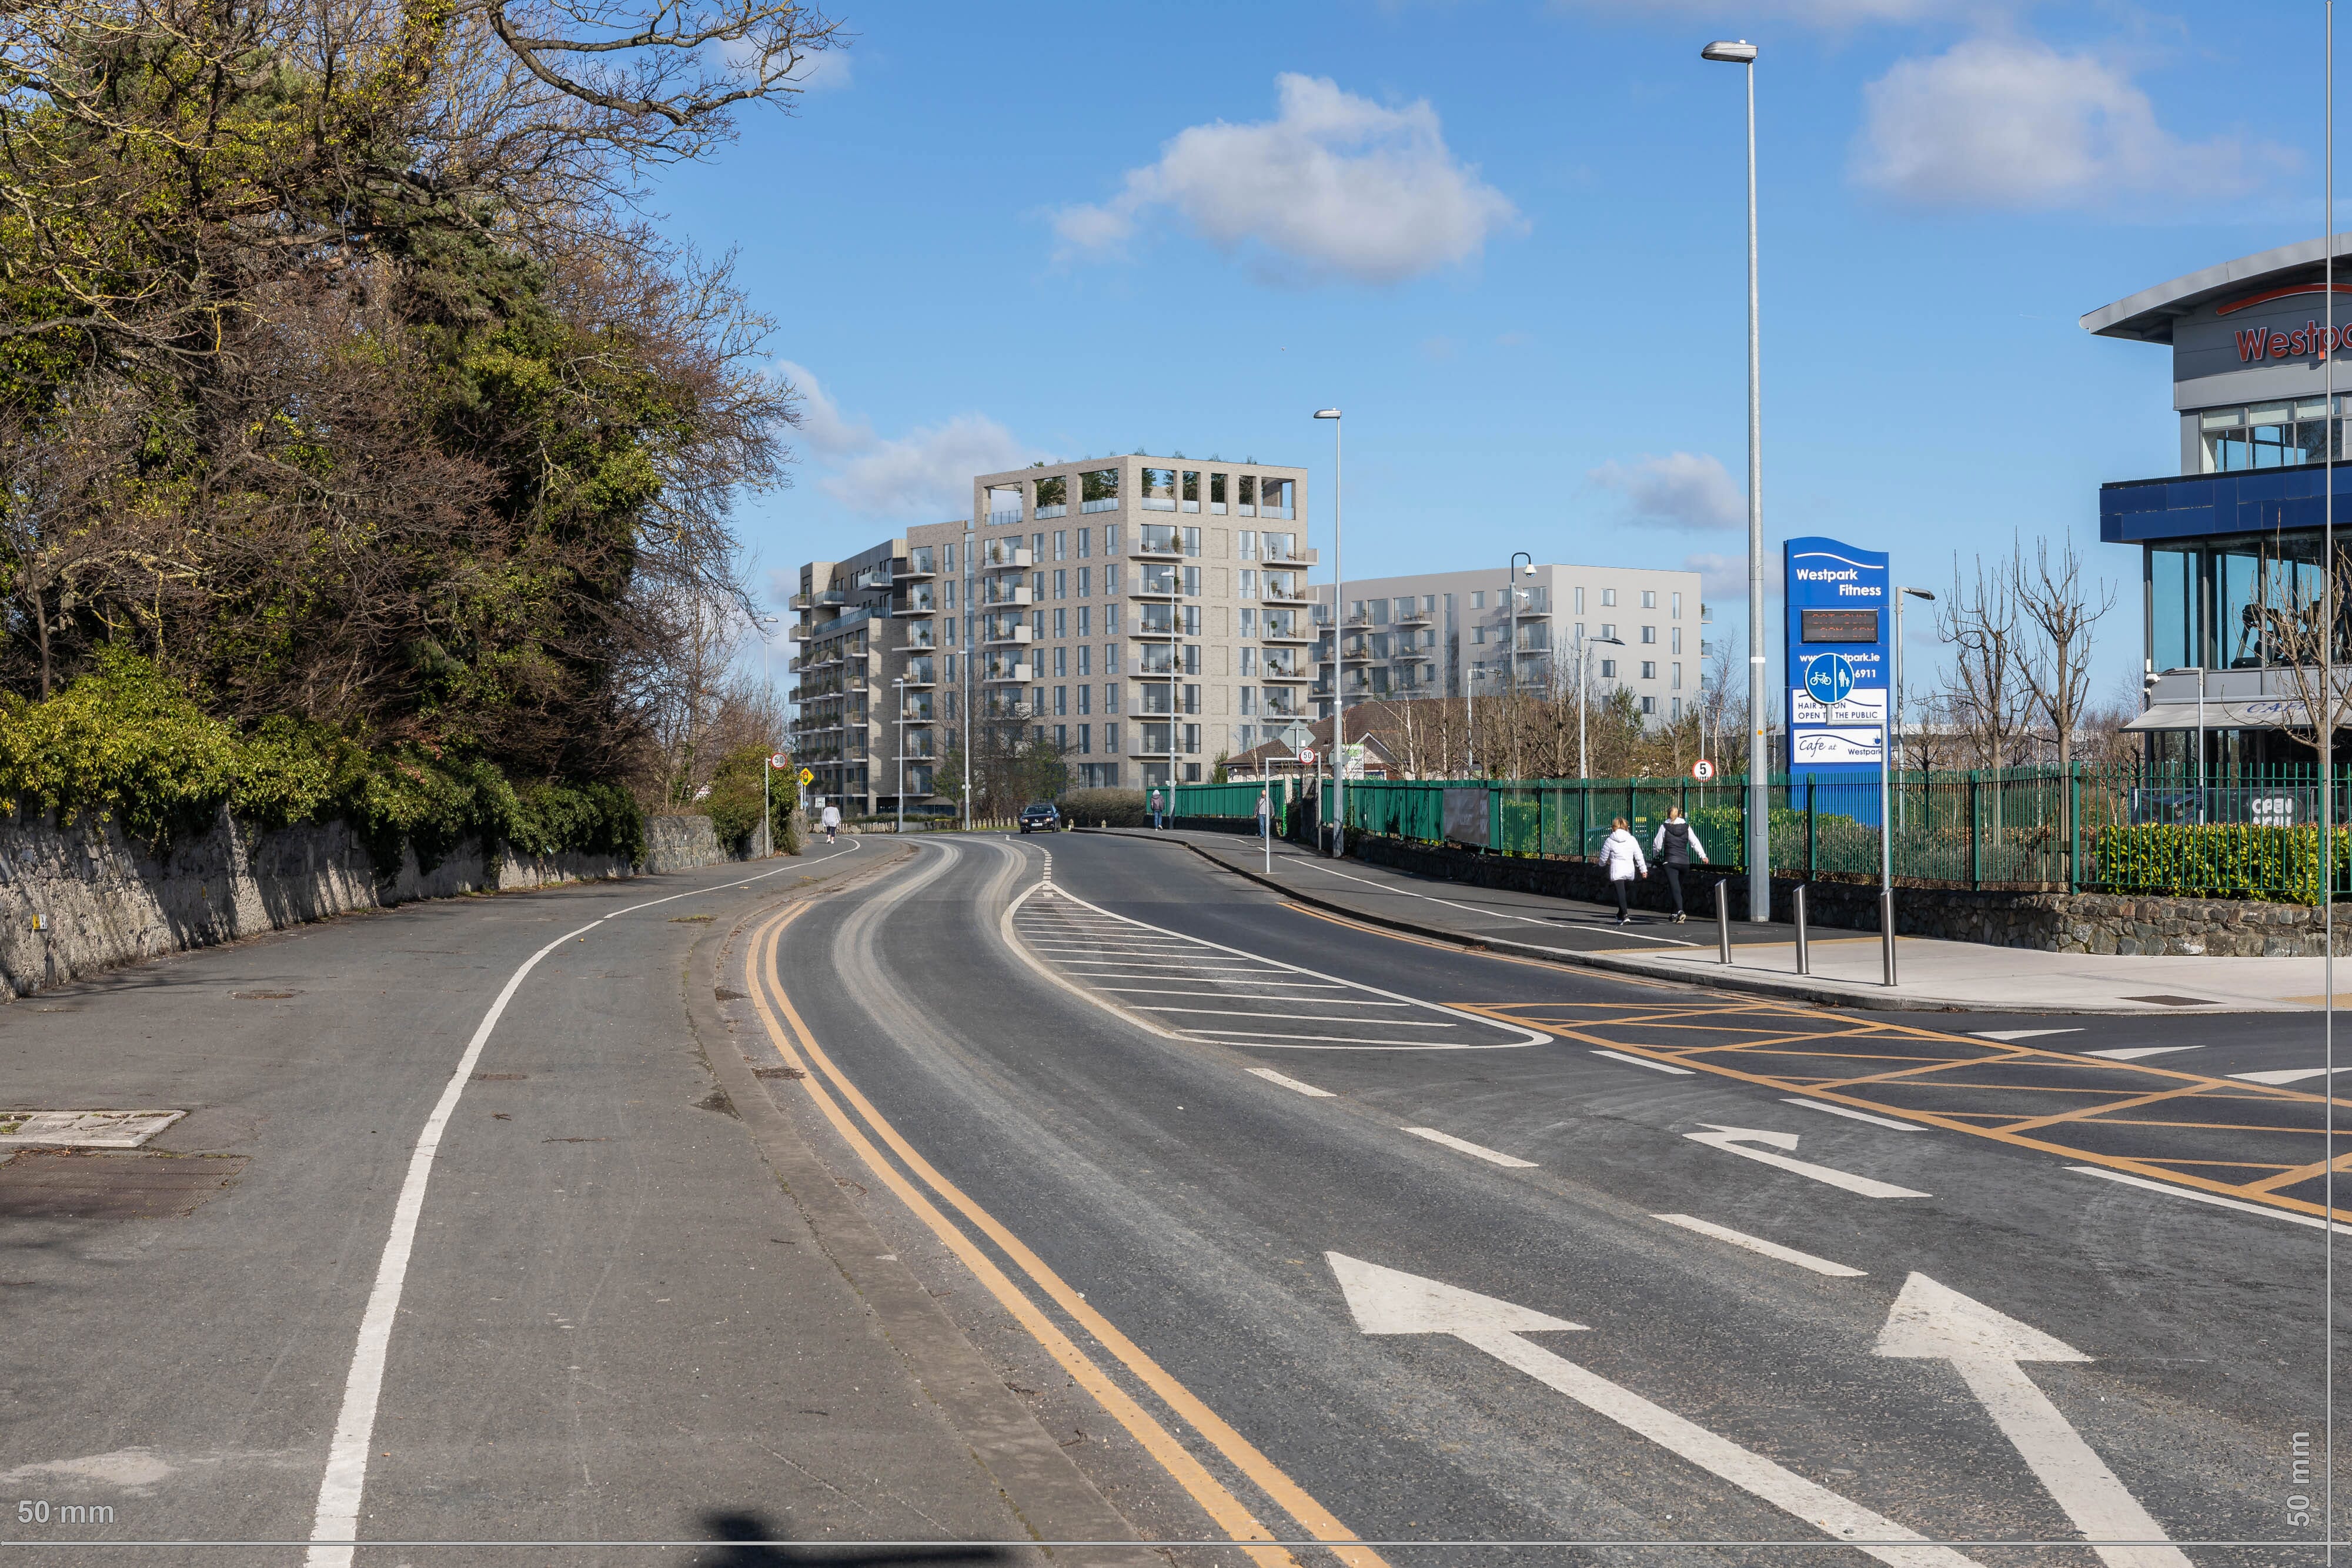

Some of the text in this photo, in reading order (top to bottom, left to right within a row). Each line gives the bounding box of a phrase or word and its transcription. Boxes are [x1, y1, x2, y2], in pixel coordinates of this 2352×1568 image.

[1796, 569, 1858, 583] Westpark
[1839, 584, 1882, 596] Fitness
[1799, 737, 1826, 757] Cafe
[1700, 763, 1706, 775] 5
[2252, 798, 2292, 814] OPEN
